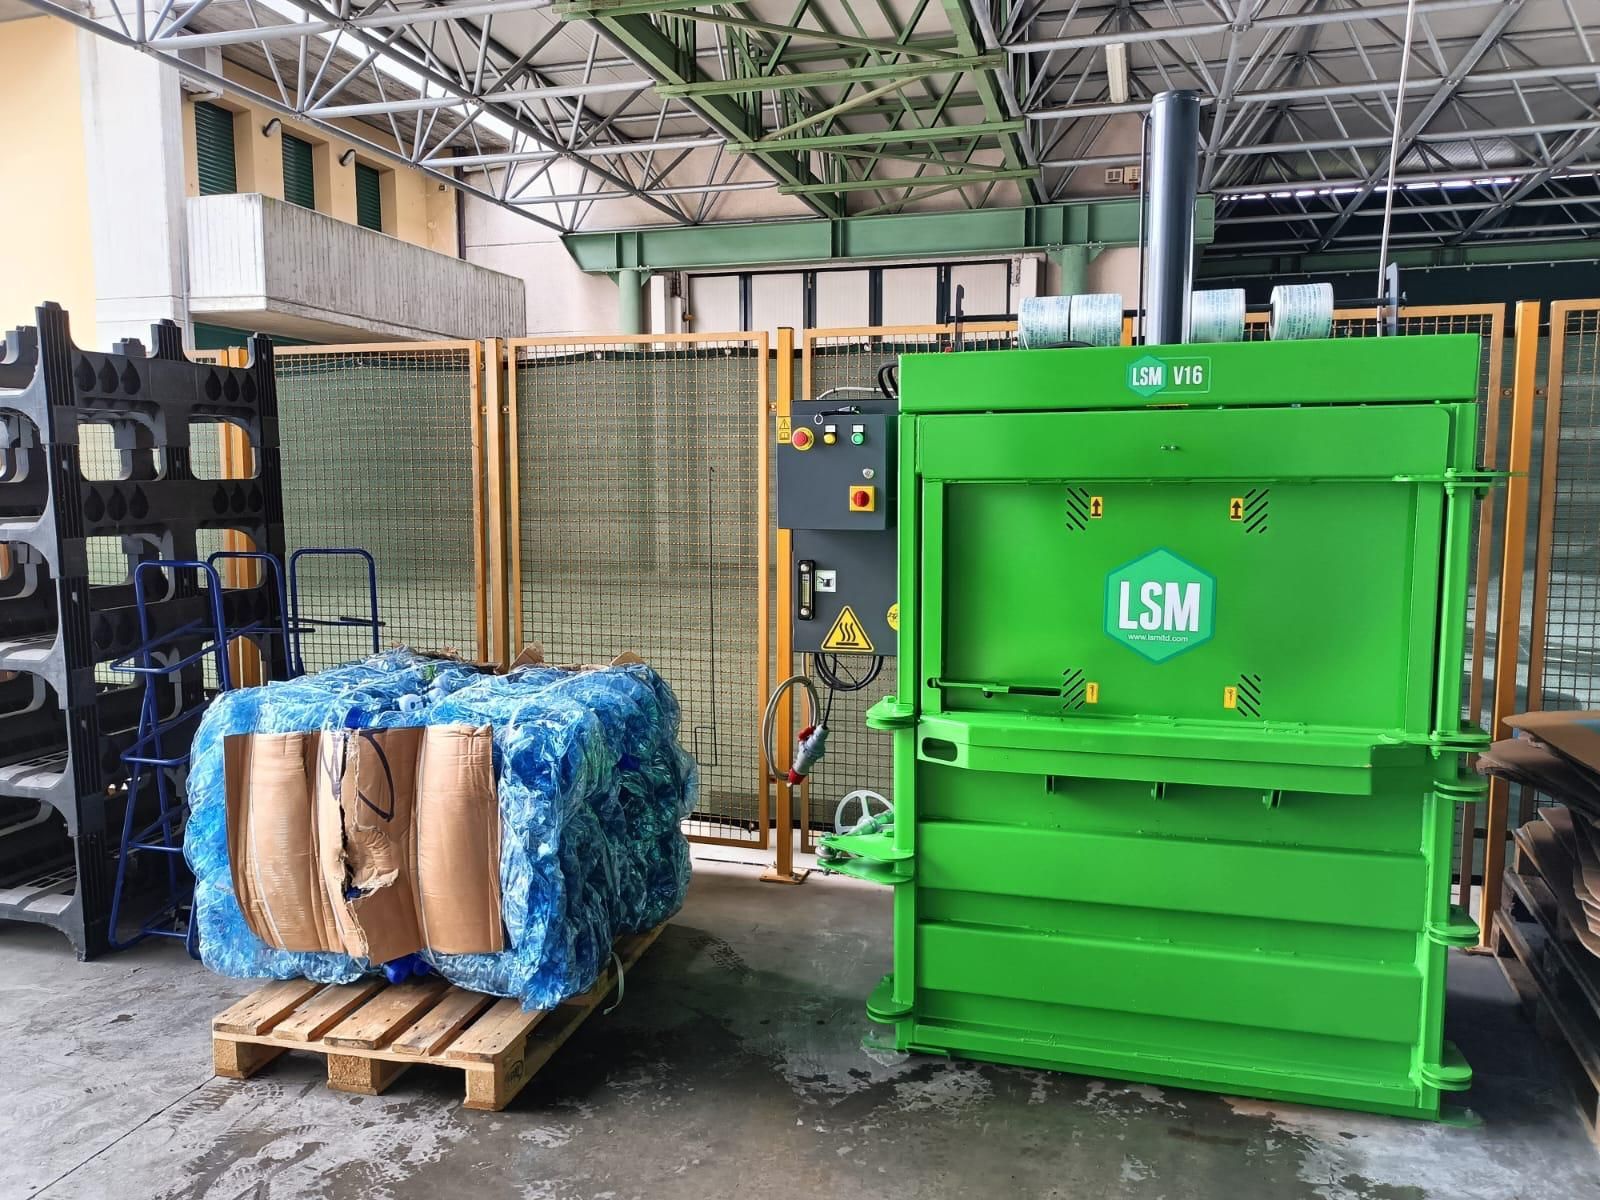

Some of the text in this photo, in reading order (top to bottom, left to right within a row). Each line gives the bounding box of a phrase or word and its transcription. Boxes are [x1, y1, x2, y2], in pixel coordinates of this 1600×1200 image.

[1132, 365, 1203, 386] LSM V16
[1119, 581, 1200, 632] LSM
